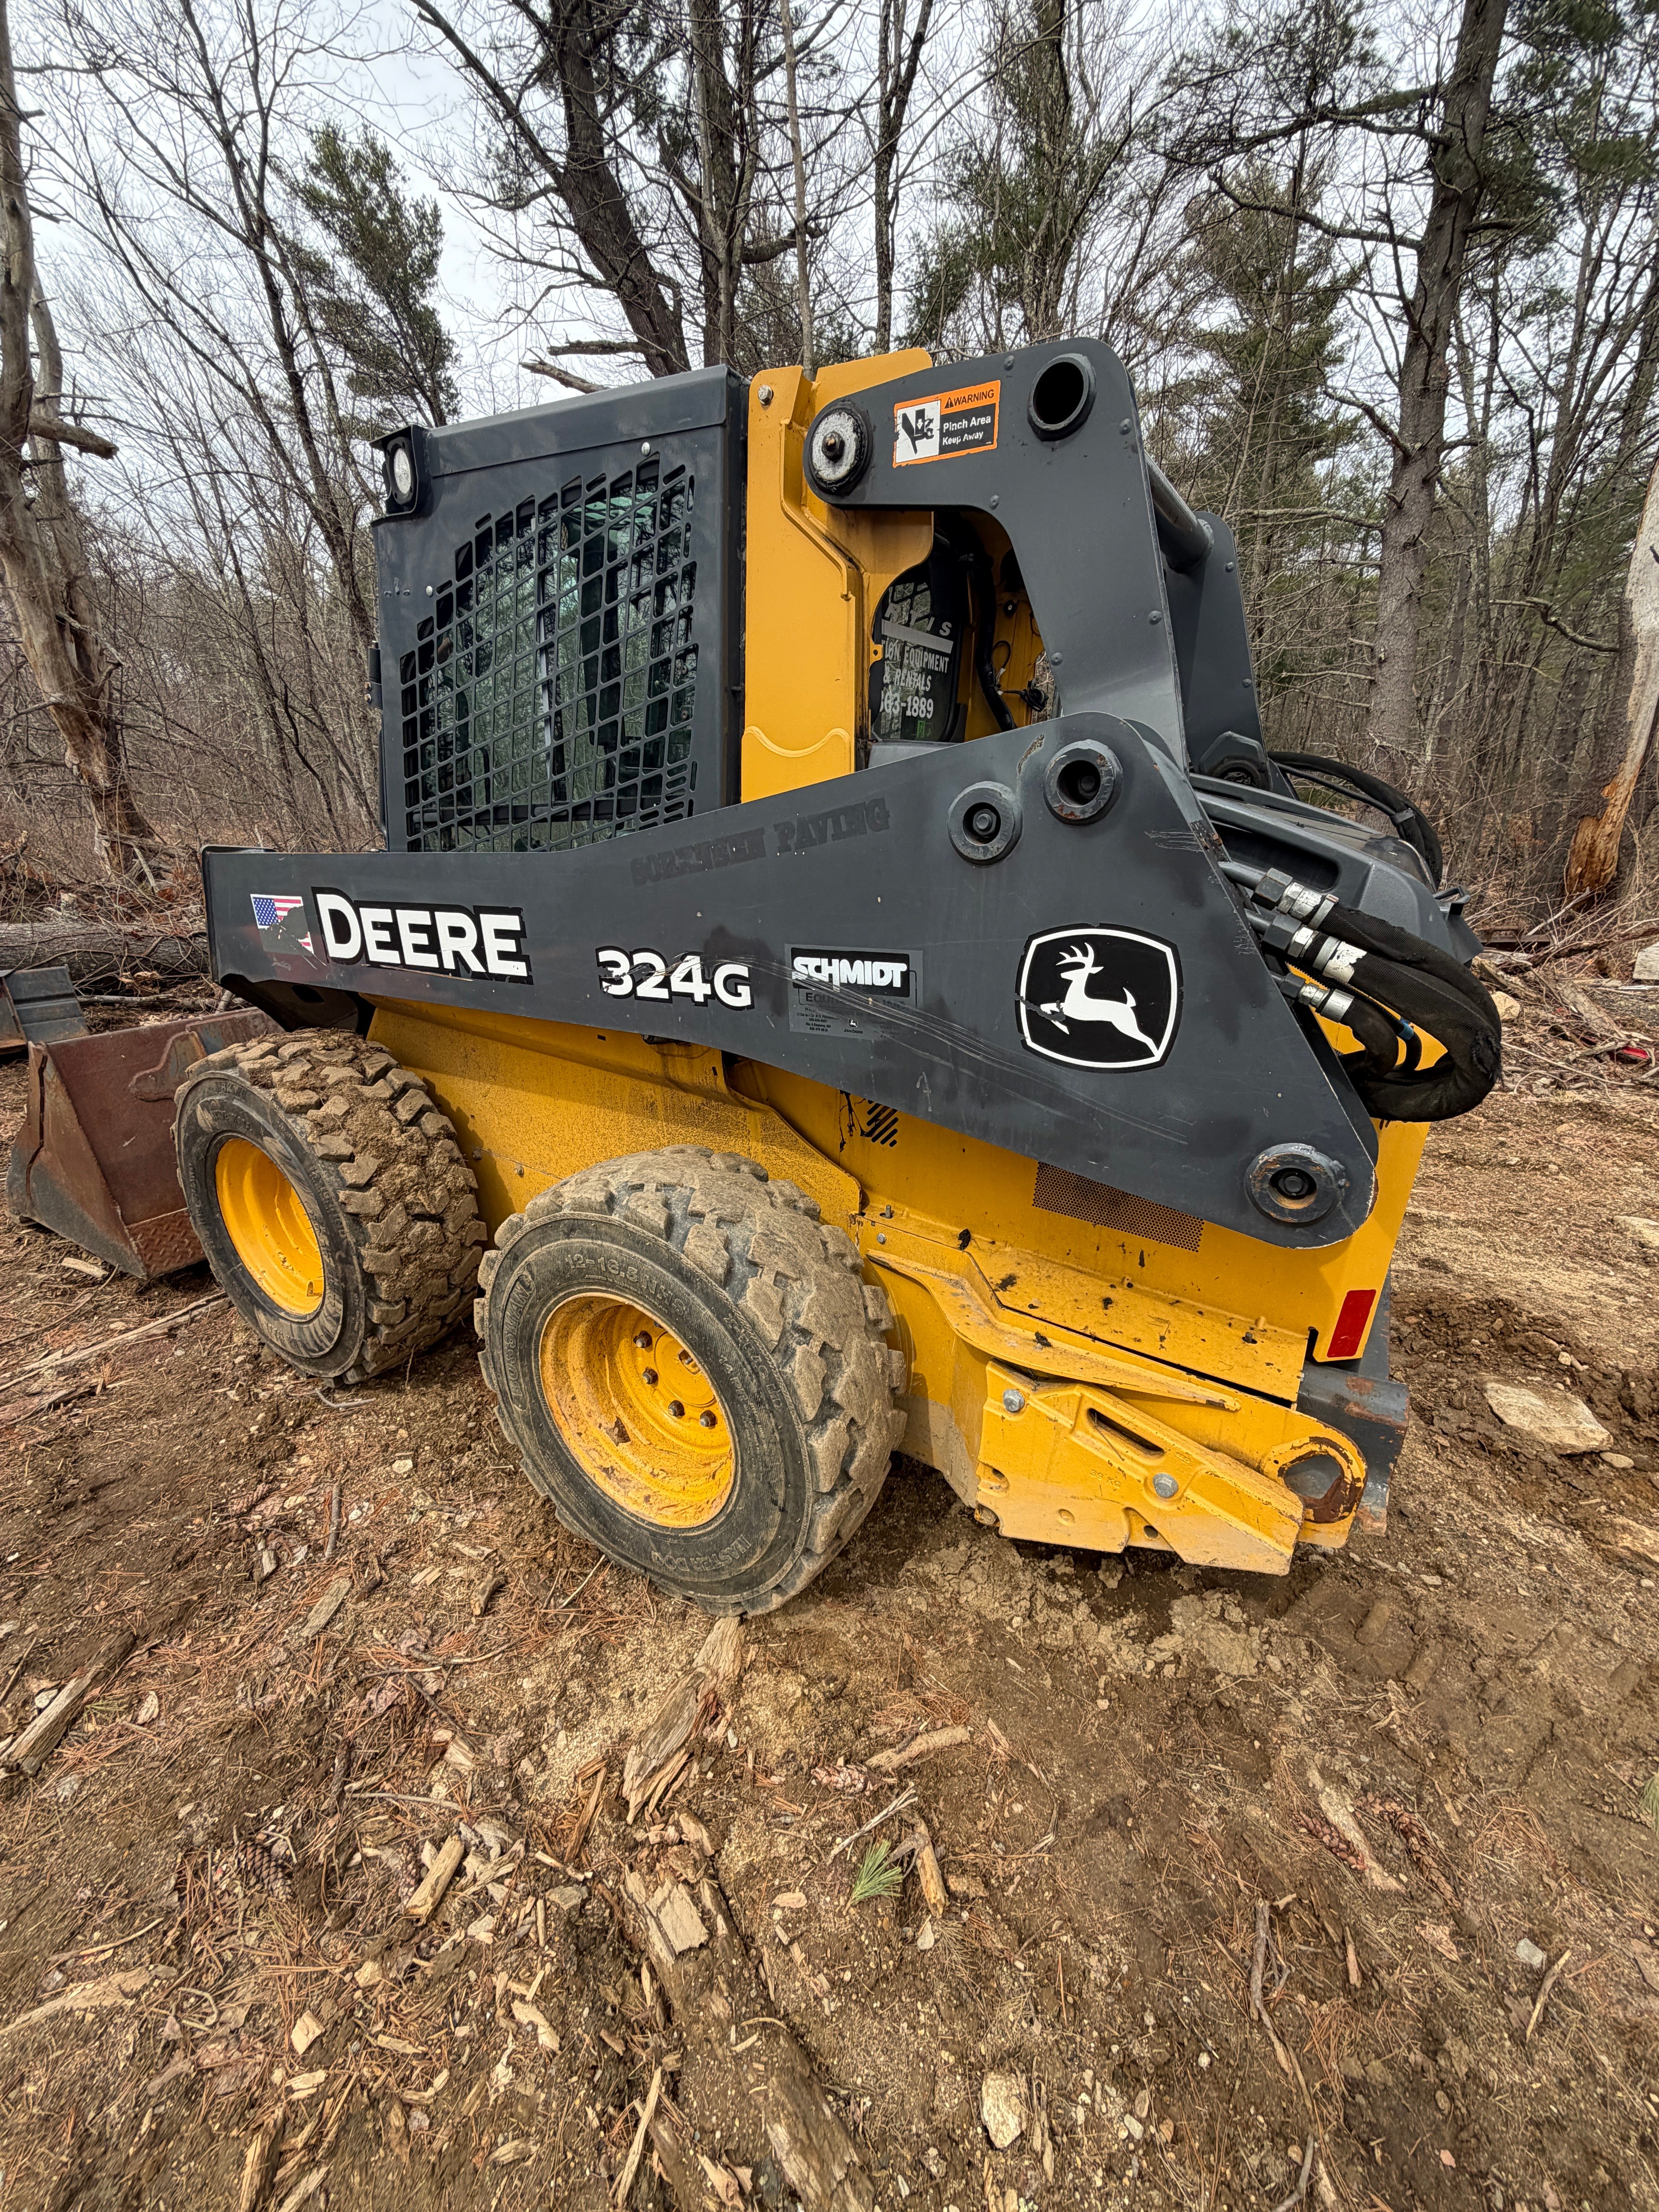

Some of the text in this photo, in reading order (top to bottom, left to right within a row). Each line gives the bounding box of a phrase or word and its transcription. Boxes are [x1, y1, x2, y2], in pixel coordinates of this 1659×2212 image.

[954, 389, 994, 406] WARNING
[943, 416, 991, 433] Pinch Area
[943, 431, 983, 445] Keep Away
[904, 646, 949, 673] EQUIPMENT
[894, 668, 932, 692] RENTALS
[773, 797, 890, 853] PAVING
[316, 893, 528, 977] DEERE
[598, 950, 750, 1007] 324G
[792, 957, 907, 989] SCHMIDT
[566, 1254, 638, 1282] 12-16.5
[641, 1274, 686, 1316] NHS
[504, 1280, 530, 1397] BOSSMAN
